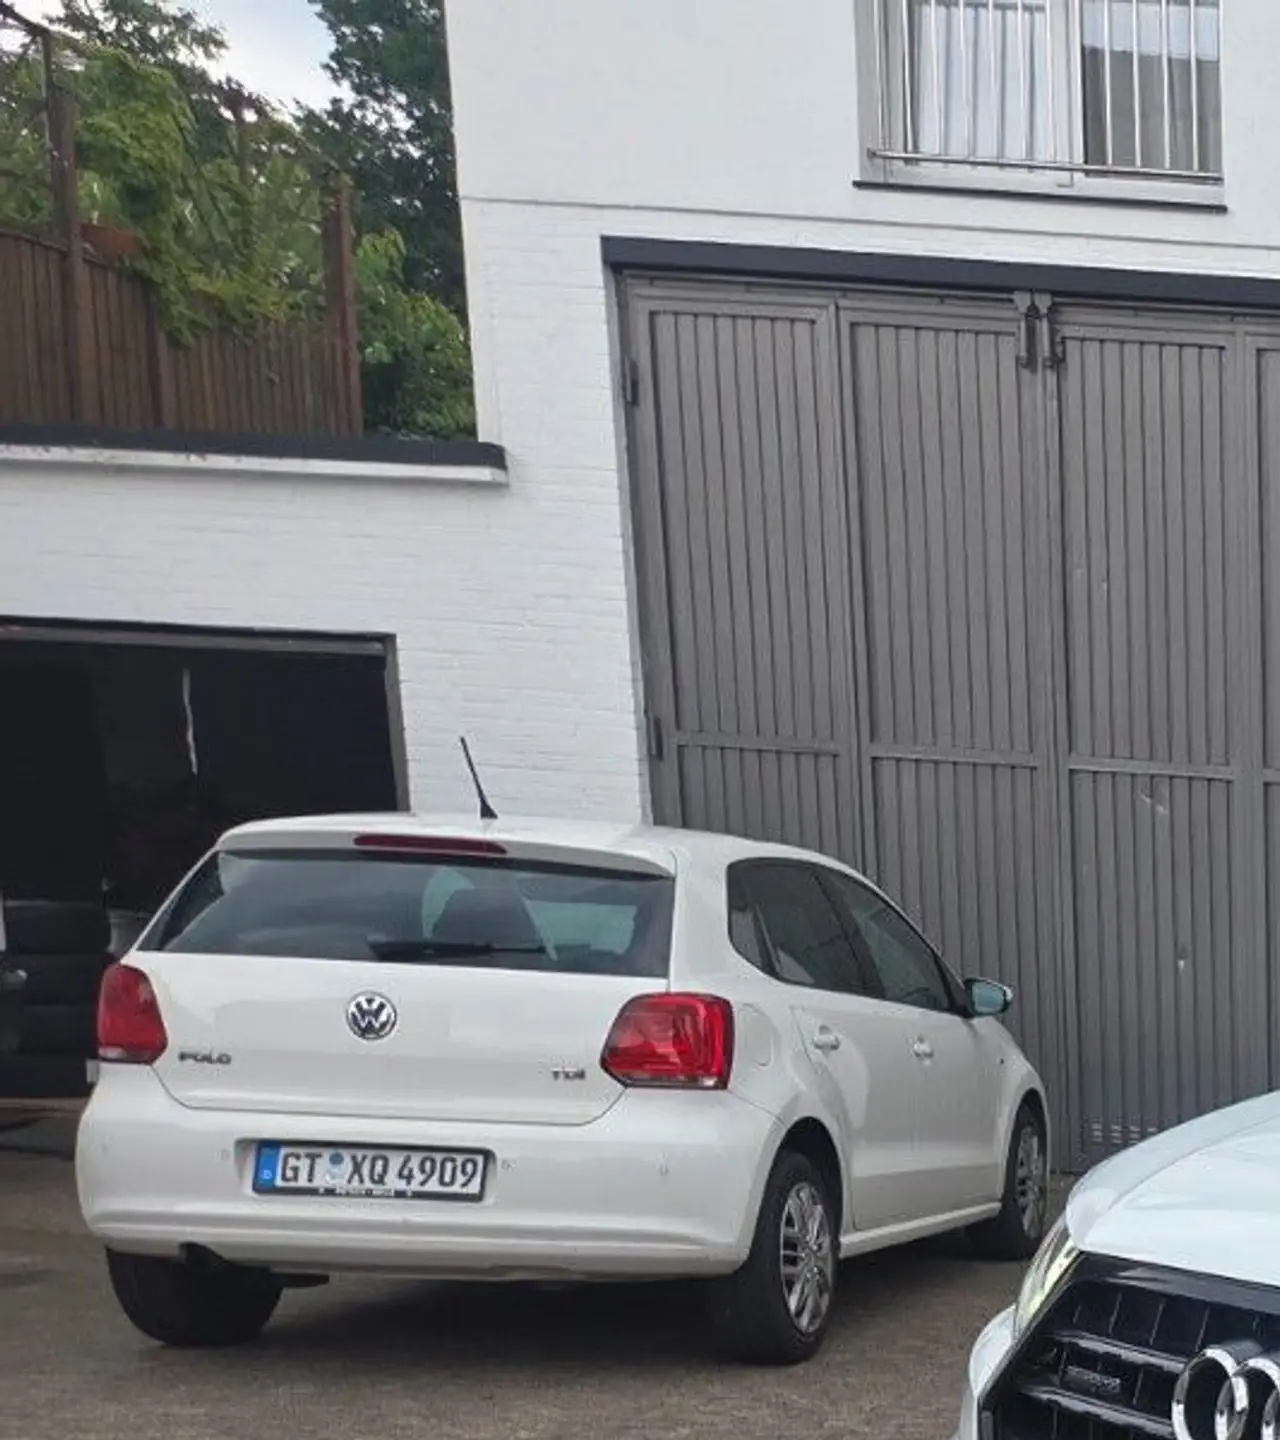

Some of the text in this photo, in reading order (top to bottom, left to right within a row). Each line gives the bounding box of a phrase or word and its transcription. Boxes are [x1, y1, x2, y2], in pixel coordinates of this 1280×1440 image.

[178, 1051, 232, 1065] POLO
[281, 1152, 478, 1189] GT XQ 4909
